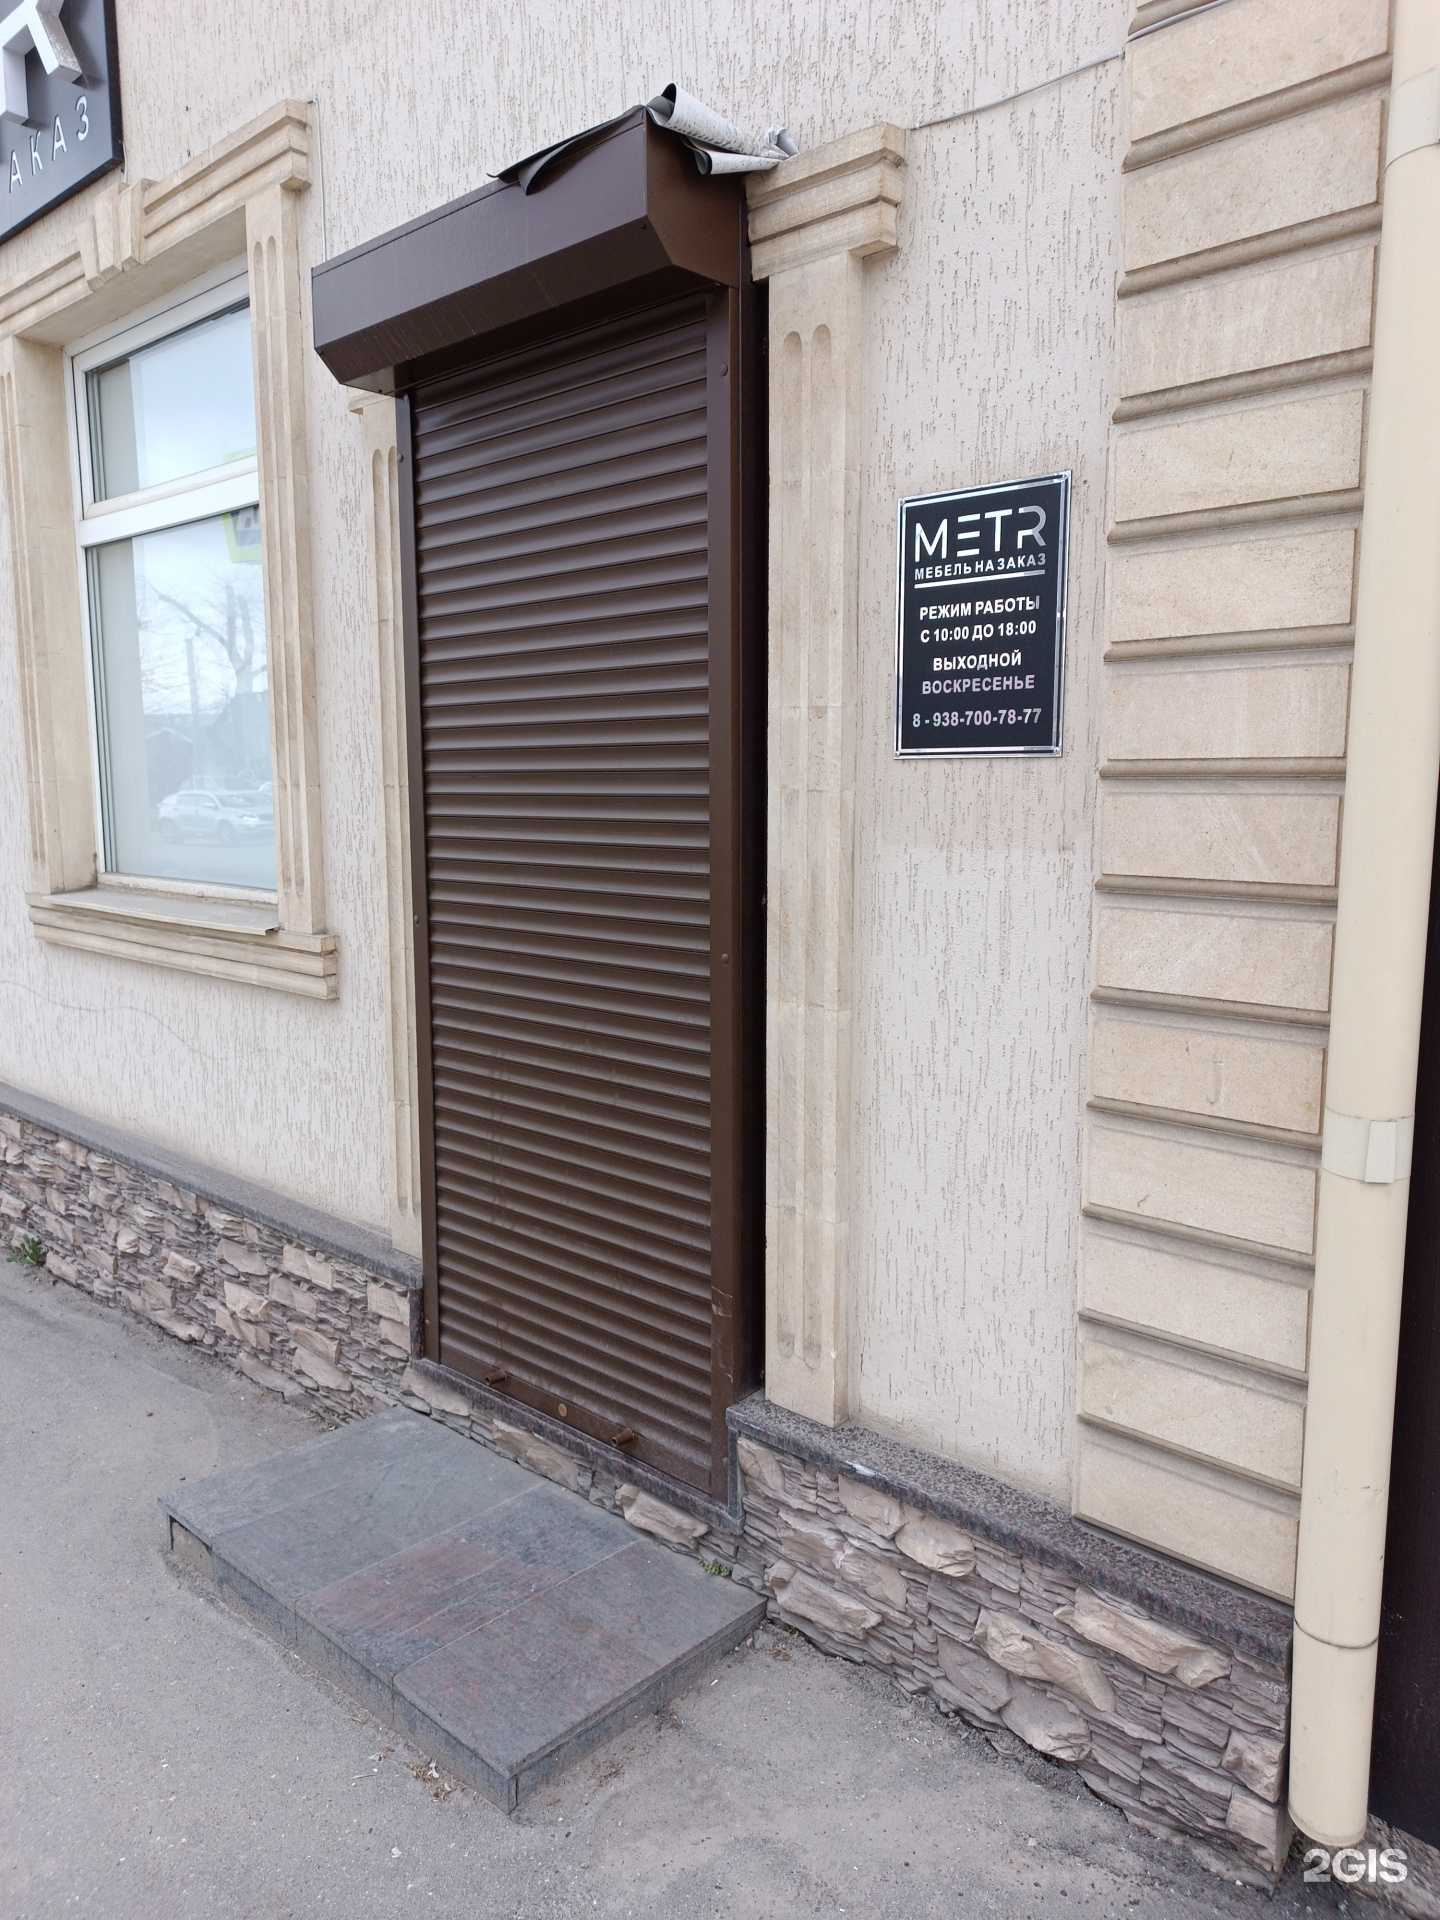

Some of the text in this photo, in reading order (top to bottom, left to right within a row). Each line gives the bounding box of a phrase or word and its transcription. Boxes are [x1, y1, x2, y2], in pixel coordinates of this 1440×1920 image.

[914, 505, 1047, 563] METR
[914, 553, 1046, 581] МЕБЕЛЬ НА ЗАКАЗ
[920, 595, 1040, 620] РЕЖИМ РАБОТЫ
[920, 620, 1037, 643] С 10:00 ДО 18:00
[933, 649, 1022, 671] ВЫХОДНОЙ
[922, 674, 1036, 694] ВОСКРЕСЕНЬЕ
